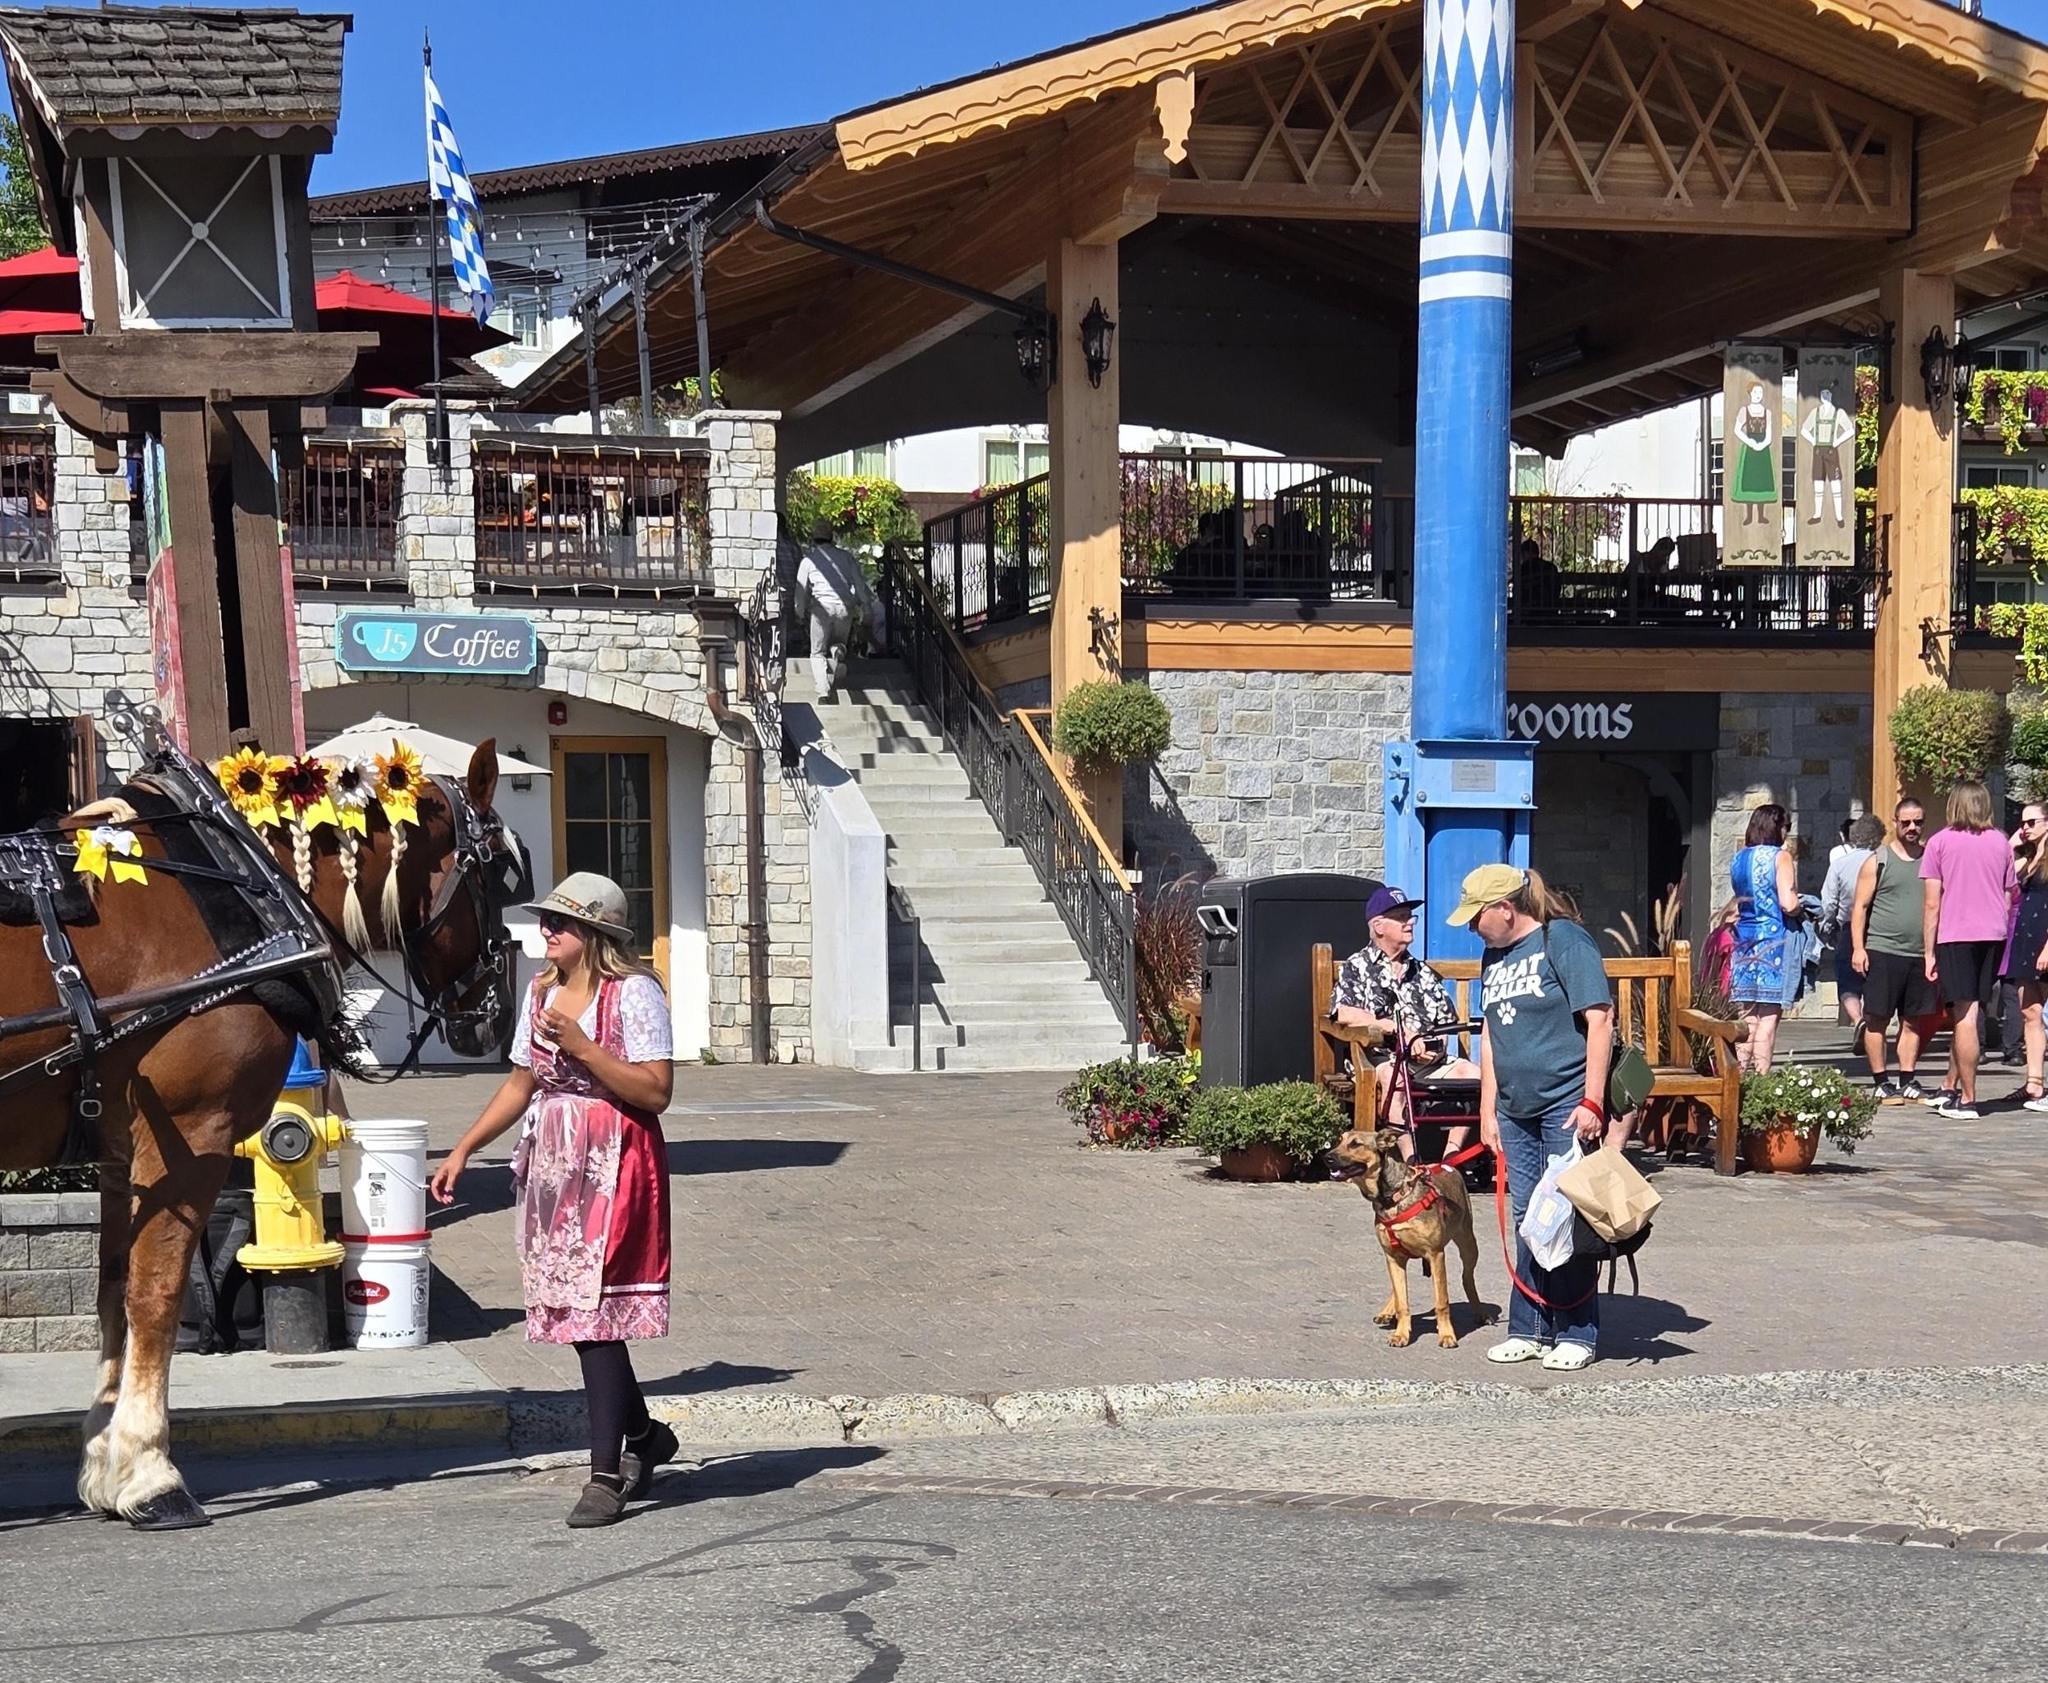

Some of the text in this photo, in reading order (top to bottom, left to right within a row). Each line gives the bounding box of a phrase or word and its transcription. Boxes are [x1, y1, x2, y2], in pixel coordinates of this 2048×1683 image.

[423, 623, 521, 666] Coffee
[1483, 952, 1545, 986] TREAT
[1482, 974, 1546, 1012] DEALER
